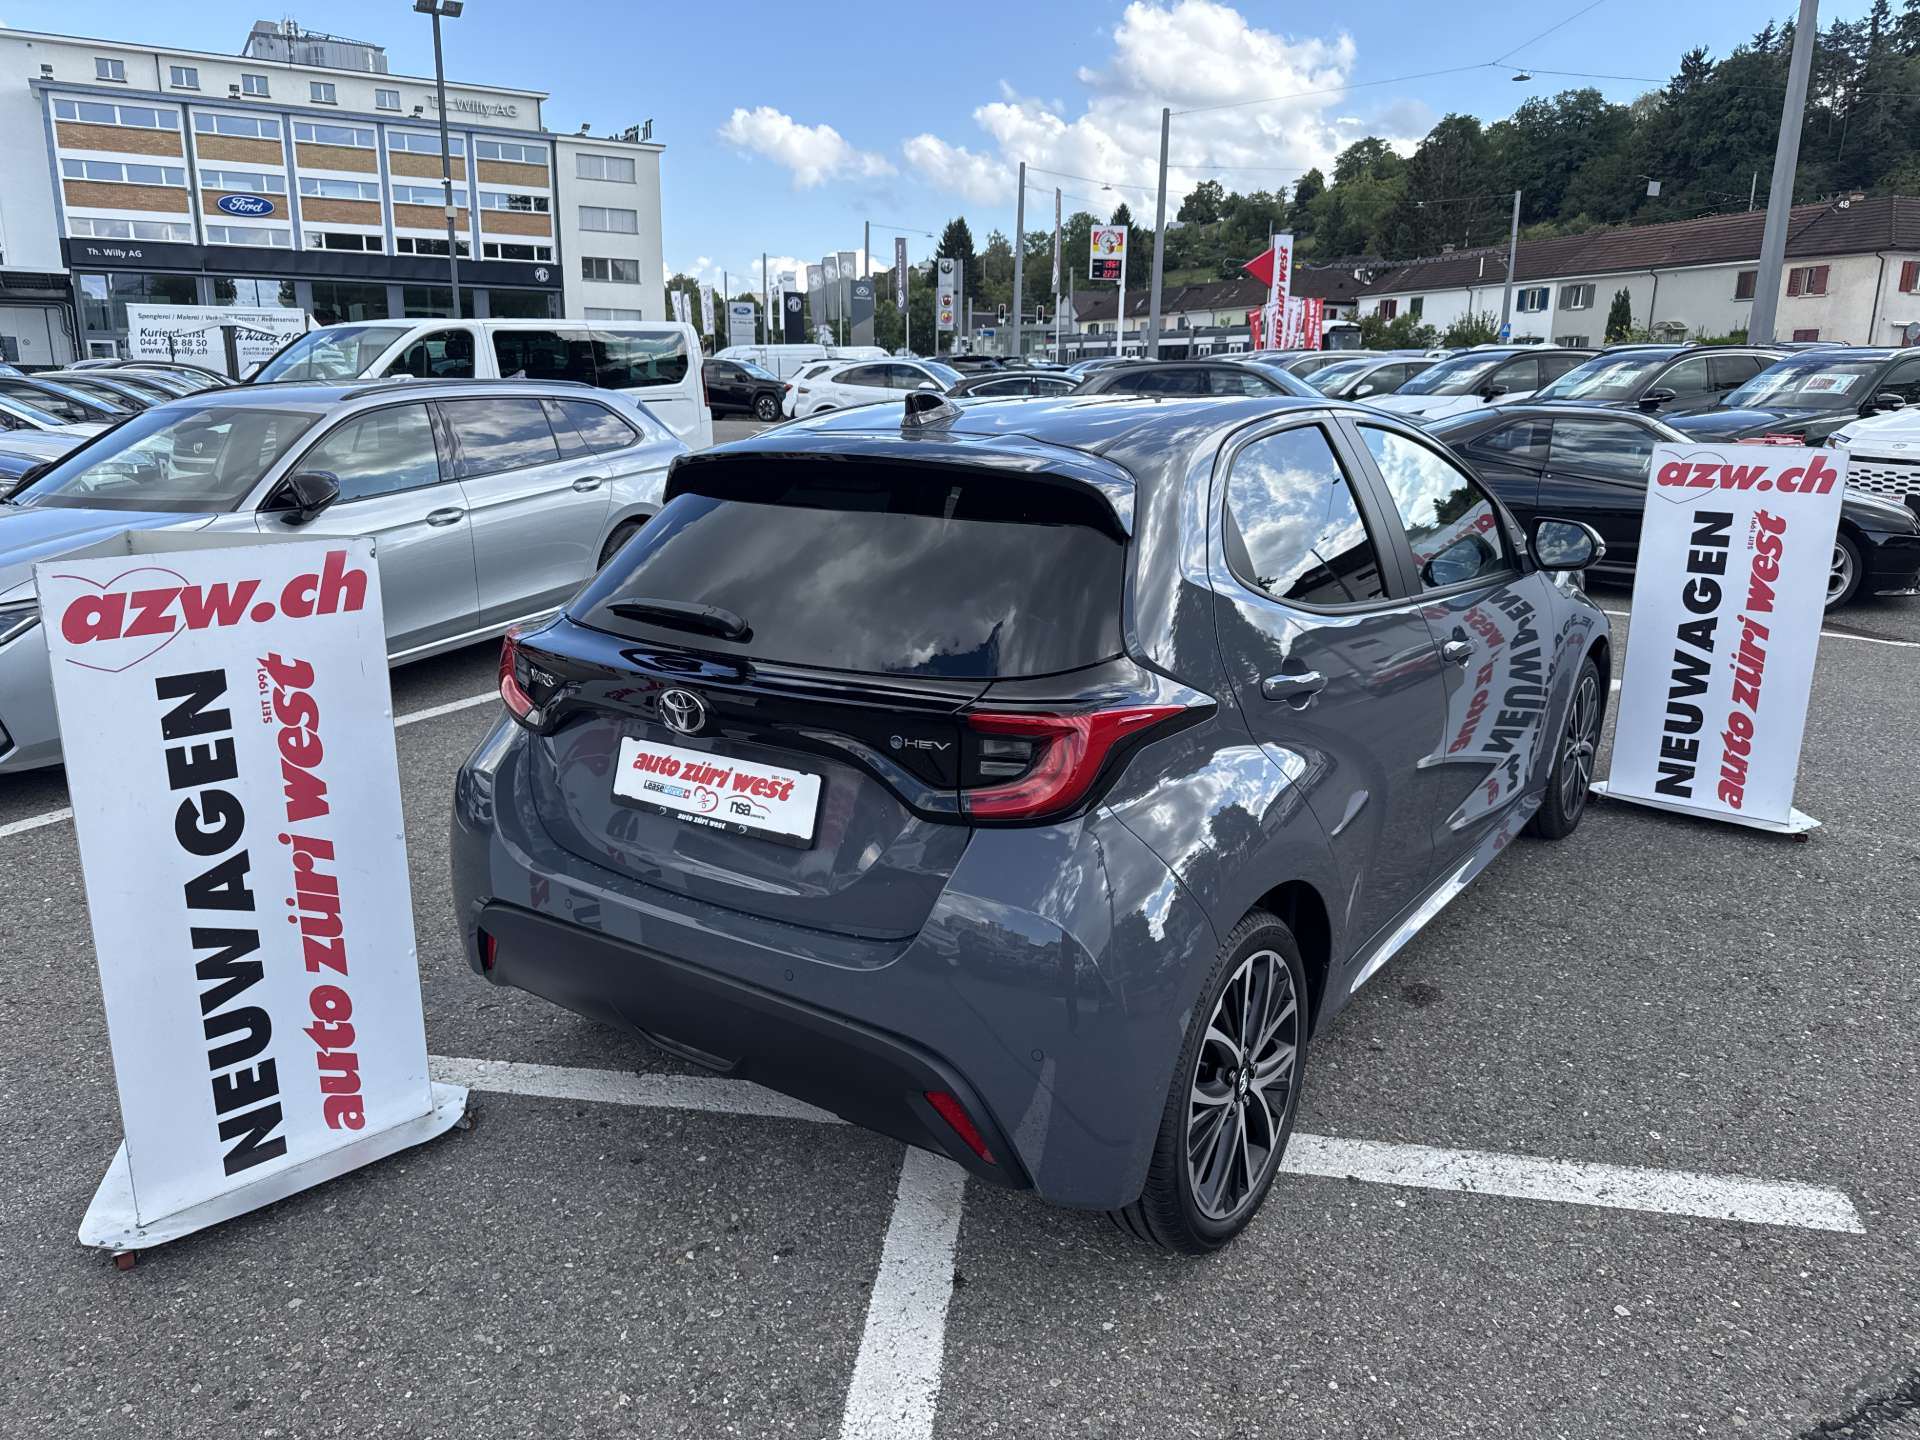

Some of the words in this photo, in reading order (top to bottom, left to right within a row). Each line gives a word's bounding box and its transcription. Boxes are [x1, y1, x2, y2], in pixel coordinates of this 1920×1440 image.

[456, 97, 490, 117] Willy
[496, 105, 519, 118] AG
[229, 197, 263, 212] Ford
[86, 247, 101, 256] Th.
[103, 248, 126, 258] Willy
[129, 249, 143, 258] AG
[140, 338, 158, 346] 044
[160, 338, 178, 347] 78
[181, 338, 192, 347] 88
[196, 339, 208, 347] 50
[1656, 456, 1838, 495] azw.ch
[1745, 509, 1787, 613] west
[61, 551, 368, 645] azw.ch
[1654, 510, 1734, 799] NEUWAGEN
[1727, 614, 1769, 713] züri
[257, 668, 269, 695] 1991
[261, 700, 272, 723] SEIT
[257, 651, 330, 823] west
[904, 738, 952, 751] HEV
[632, 752, 681, 777] auto
[678, 761, 735, 788] züri
[731, 772, 796, 802] west
[1717, 711, 1754, 810] auto
[676, 812, 694, 822] auto
[693, 815, 710, 827] züri
[709, 819, 727, 831] west
[729, 800, 751, 817] nsa
[155, 668, 288, 1178] NEUWAGEN
[278, 833, 348, 977] züri
[303, 986, 365, 1131] auto
